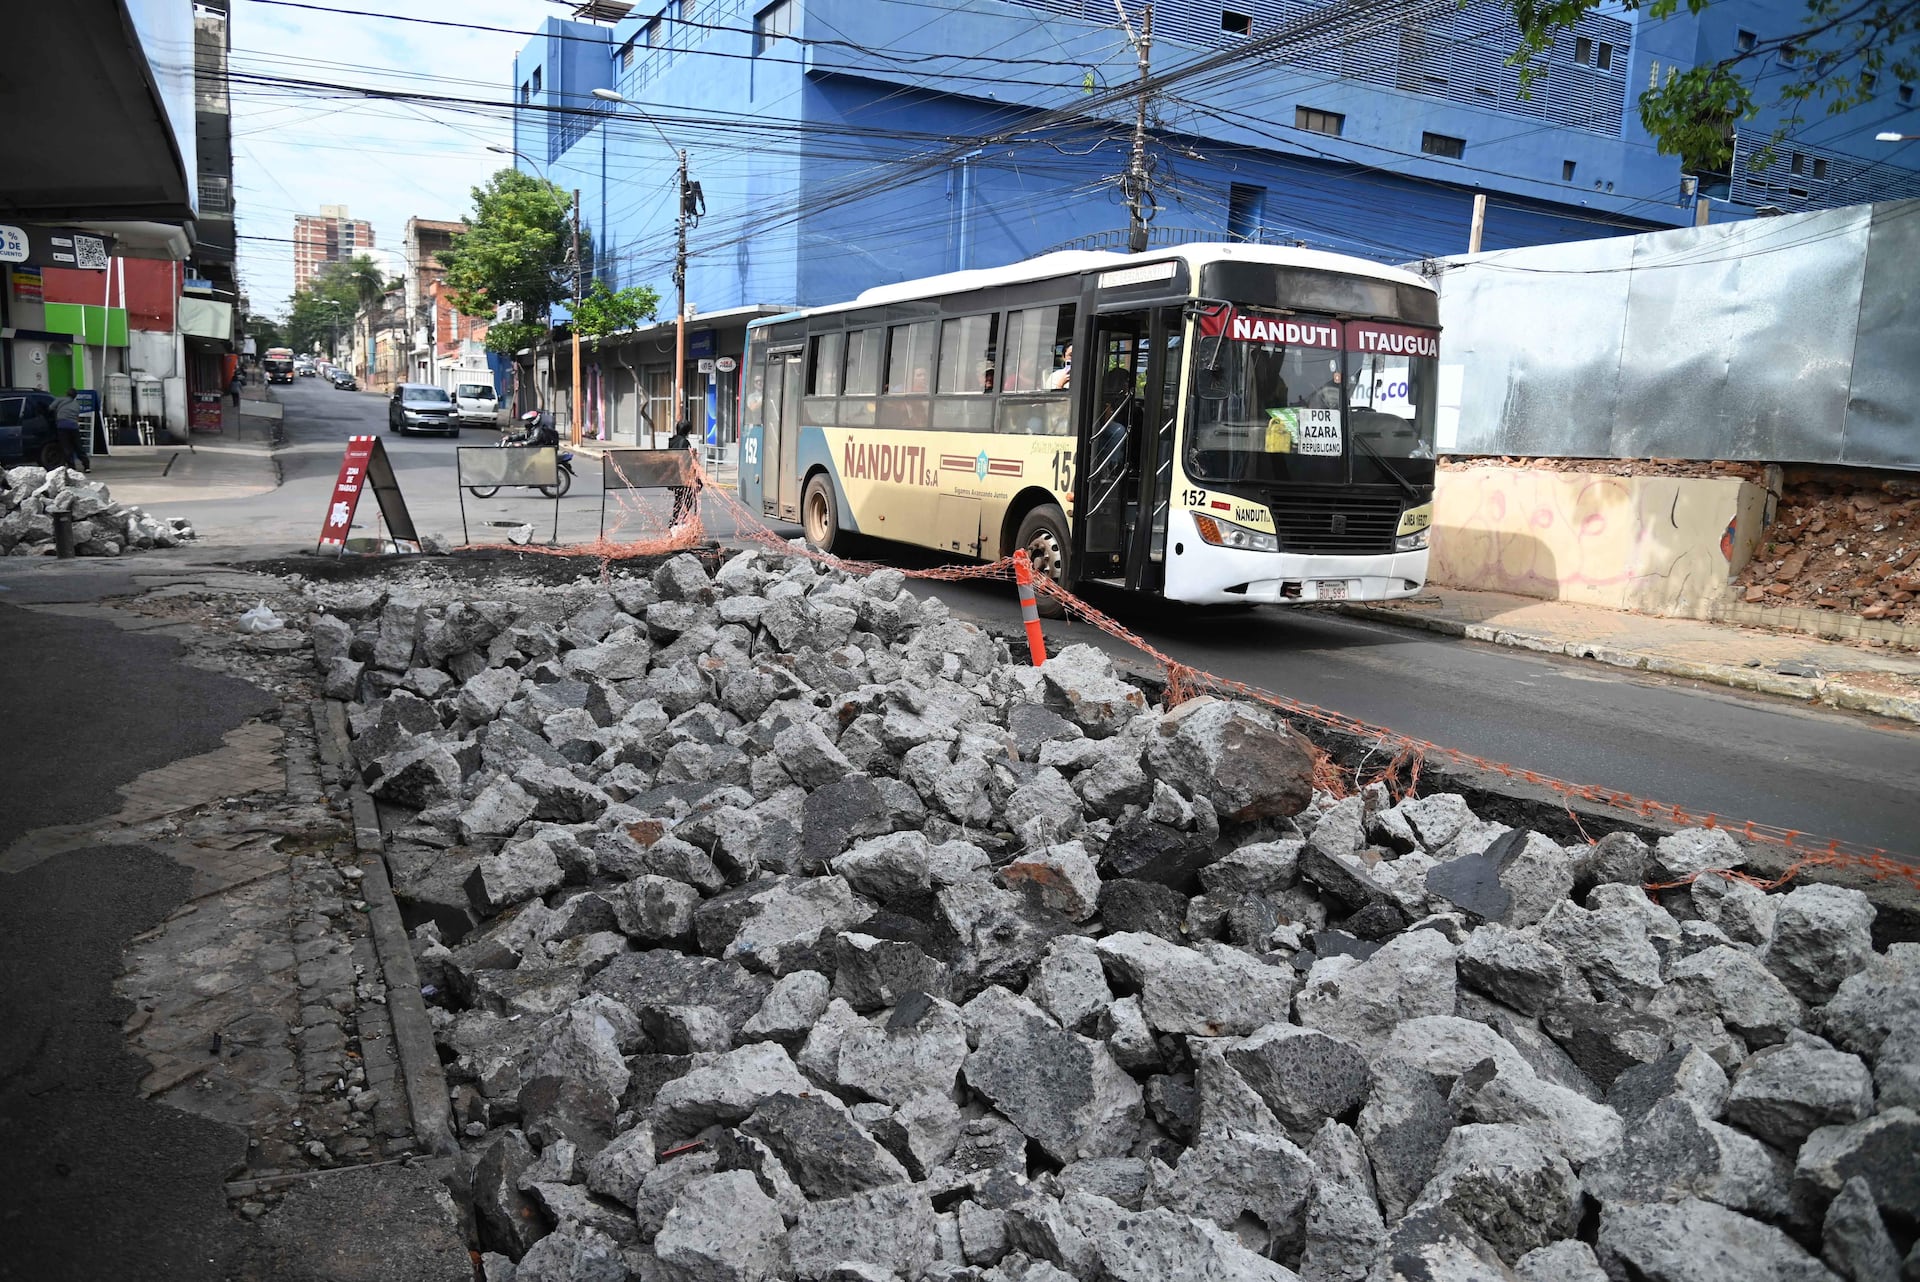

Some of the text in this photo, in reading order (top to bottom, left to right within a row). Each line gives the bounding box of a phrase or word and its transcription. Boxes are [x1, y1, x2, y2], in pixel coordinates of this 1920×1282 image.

[9, 241, 21, 250] DE
[1233, 316, 1437, 357] ÑANDUTI ITAUGUA
[1311, 410, 1331, 422] POR
[1304, 426, 1338, 438] AZARA
[745, 437, 758, 464] 152
[1301, 443, 1341, 453] REPUBLICANO
[844, 435, 926, 486] ÑANDUTI
[1182, 489, 1206, 506] 152
